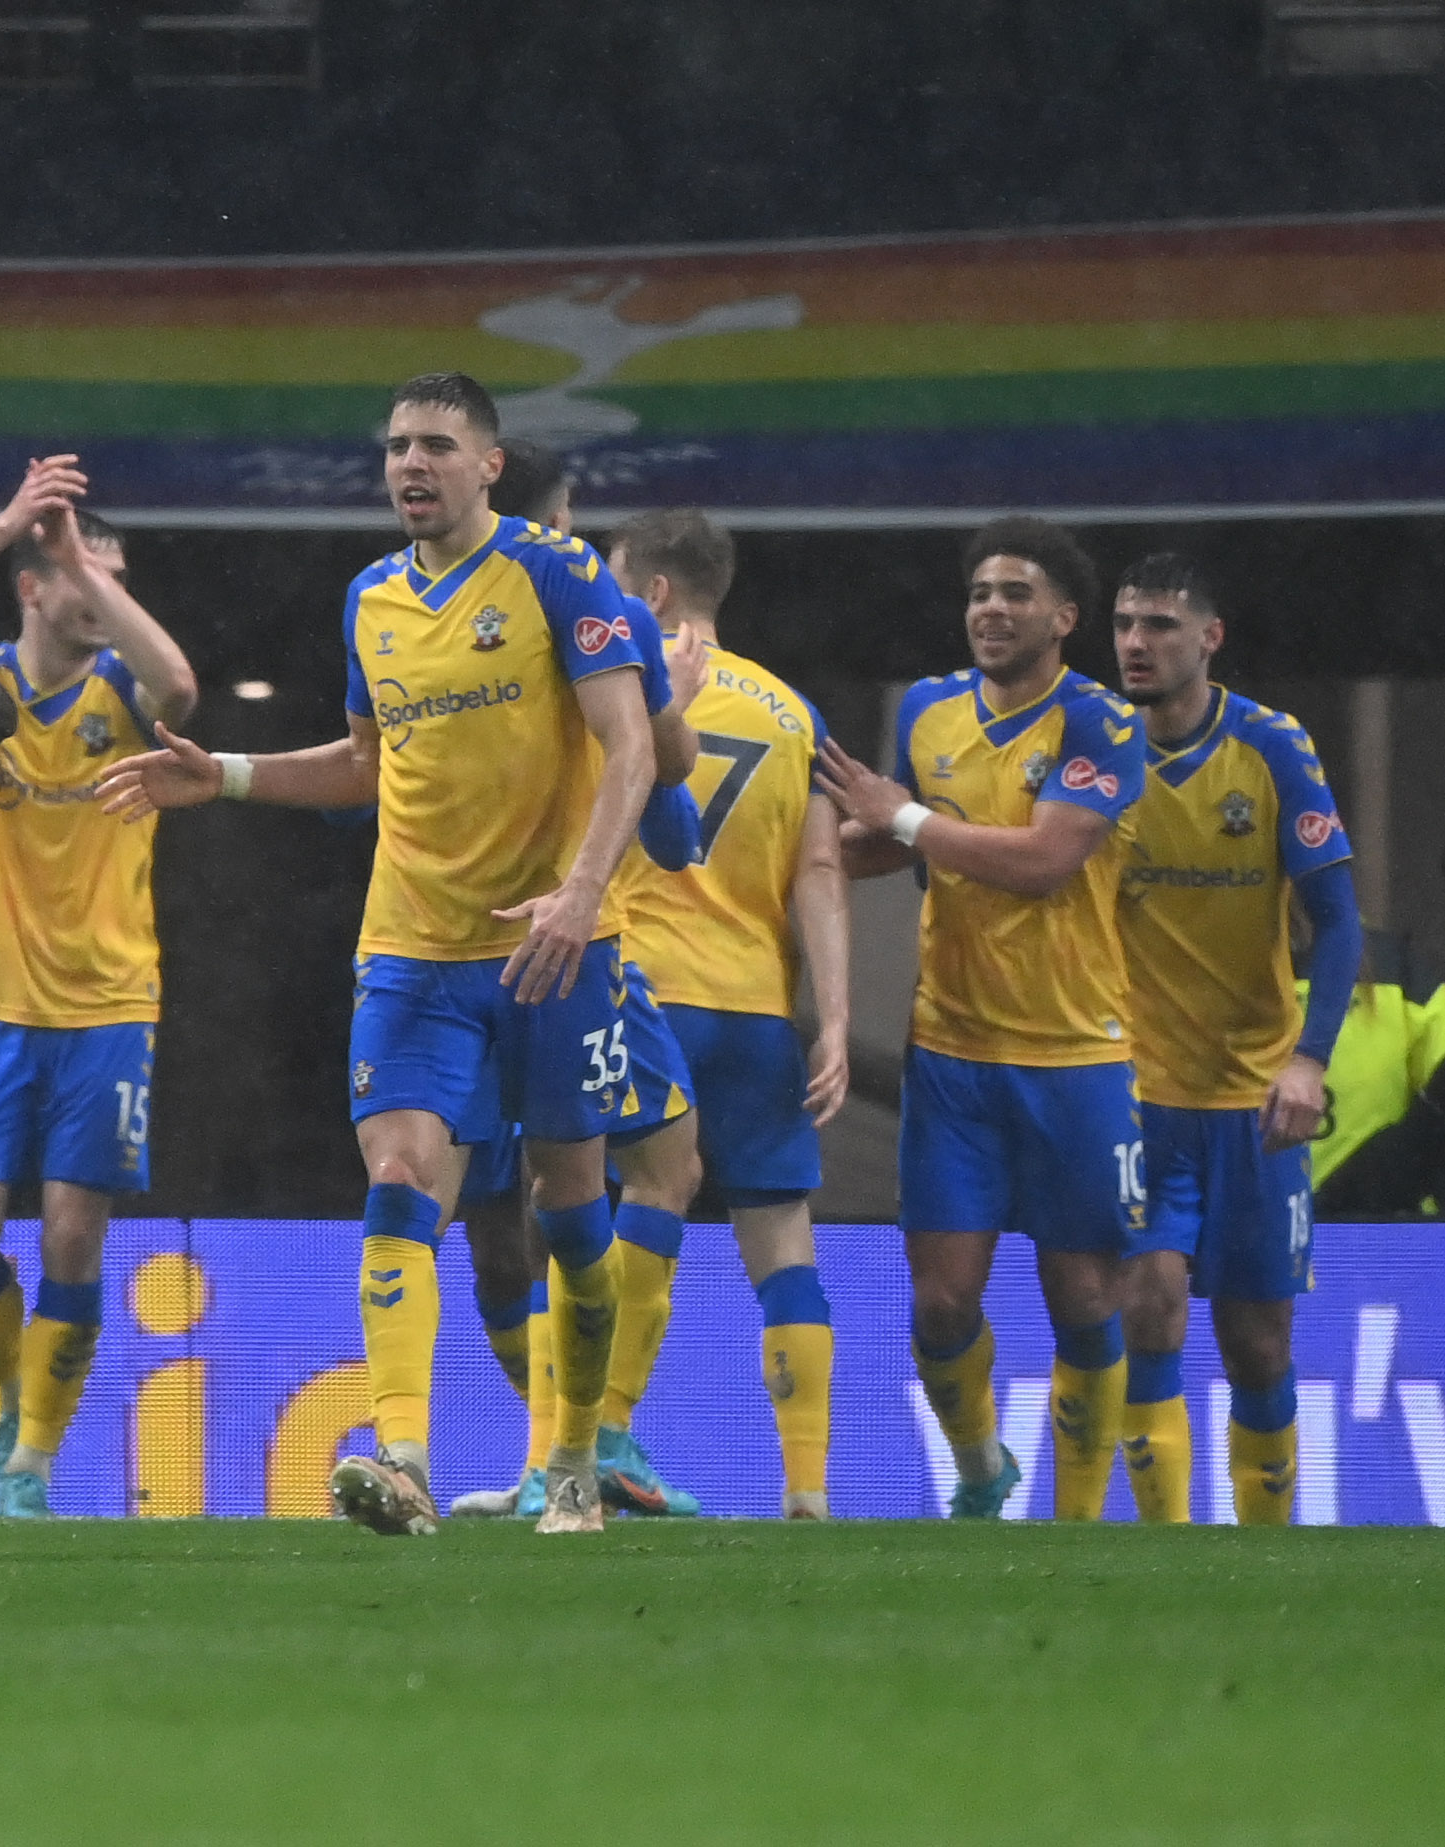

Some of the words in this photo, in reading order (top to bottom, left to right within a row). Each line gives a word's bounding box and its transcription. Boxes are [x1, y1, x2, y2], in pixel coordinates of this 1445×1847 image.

[378, 679, 522, 731] Sportsbet.io
[716, 669, 803, 732] RONG
[695, 730, 772, 867] 7
[581, 1019, 628, 1092] 35
[115, 1081, 149, 1144] 15
